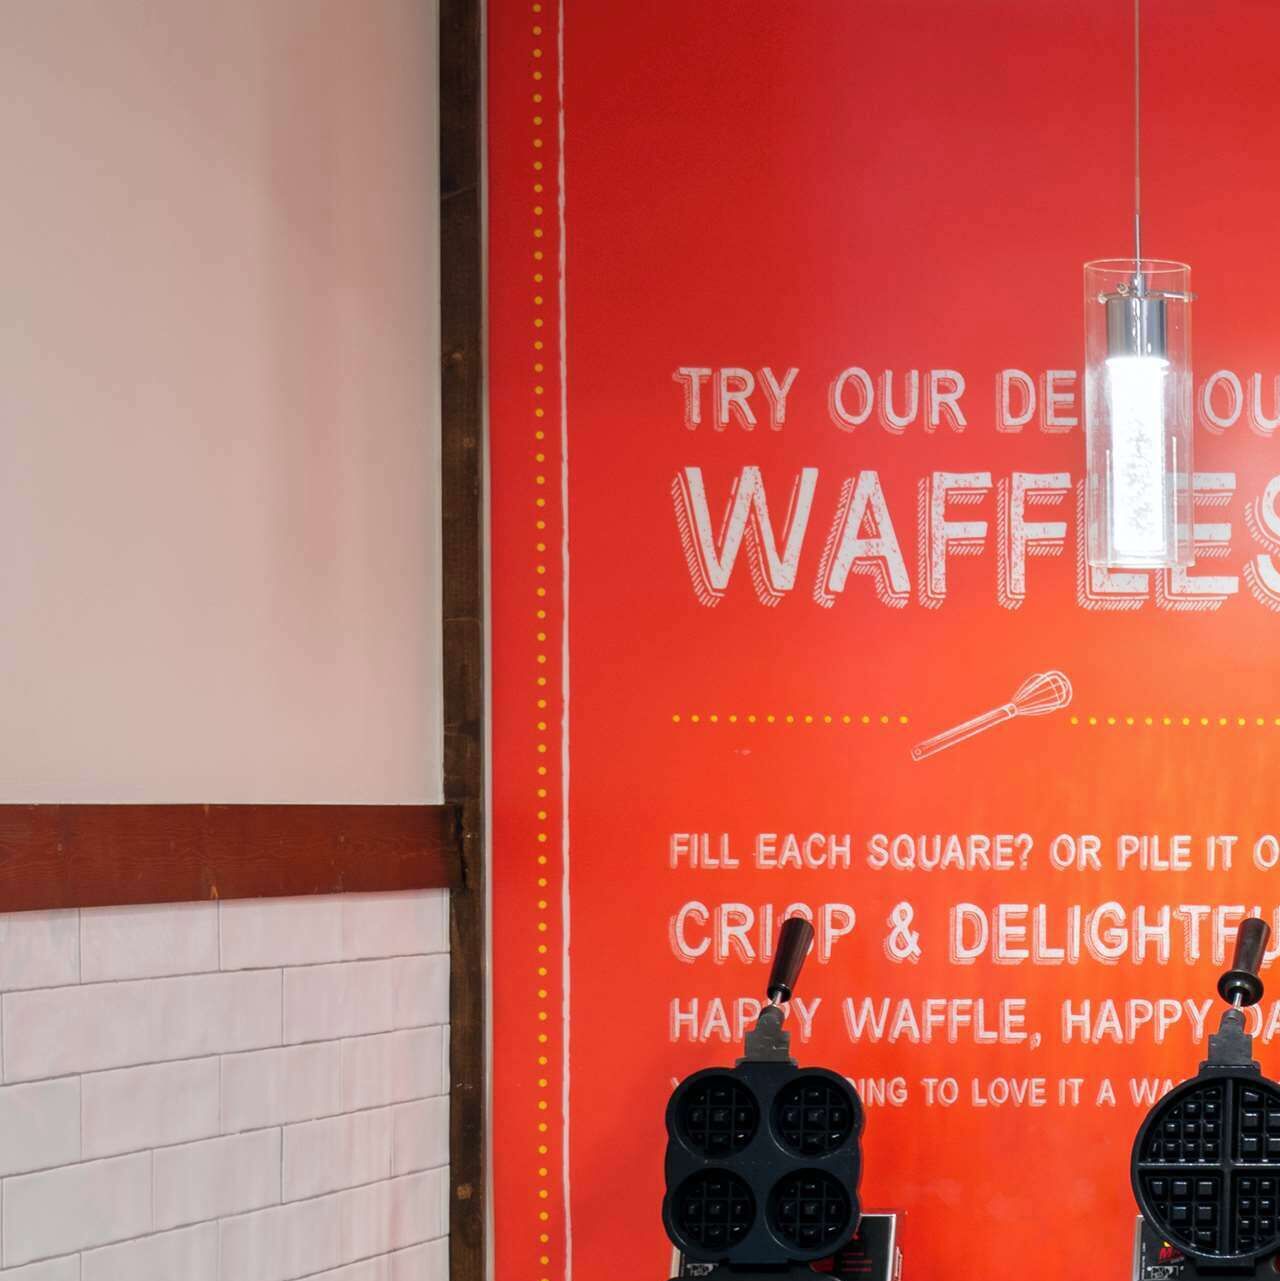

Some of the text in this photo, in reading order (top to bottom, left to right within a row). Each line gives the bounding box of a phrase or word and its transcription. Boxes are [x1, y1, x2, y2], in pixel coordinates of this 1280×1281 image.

[672, 366, 800, 432] TRY
[829, 366, 967, 434] OUR
[669, 833, 739, 870] FILL
[754, 832, 852, 870] EACH
[867, 832, 1034, 872] SQUARE?
[1050, 833, 1102, 870] OR
[1117, 834, 1192, 871] PILE
[1204, 834, 1239, 870] IT
[885, 900, 924, 965] &
[841, 996, 1042, 1051] WAFFLE,
[1062, 997, 1214, 1045] HAPPY
[920, 1077, 961, 1107] TO
[971, 1077, 1047, 1107] LOVE
[1057, 1077, 1085, 1107] IT
[1095, 1077, 1118, 1107] A
